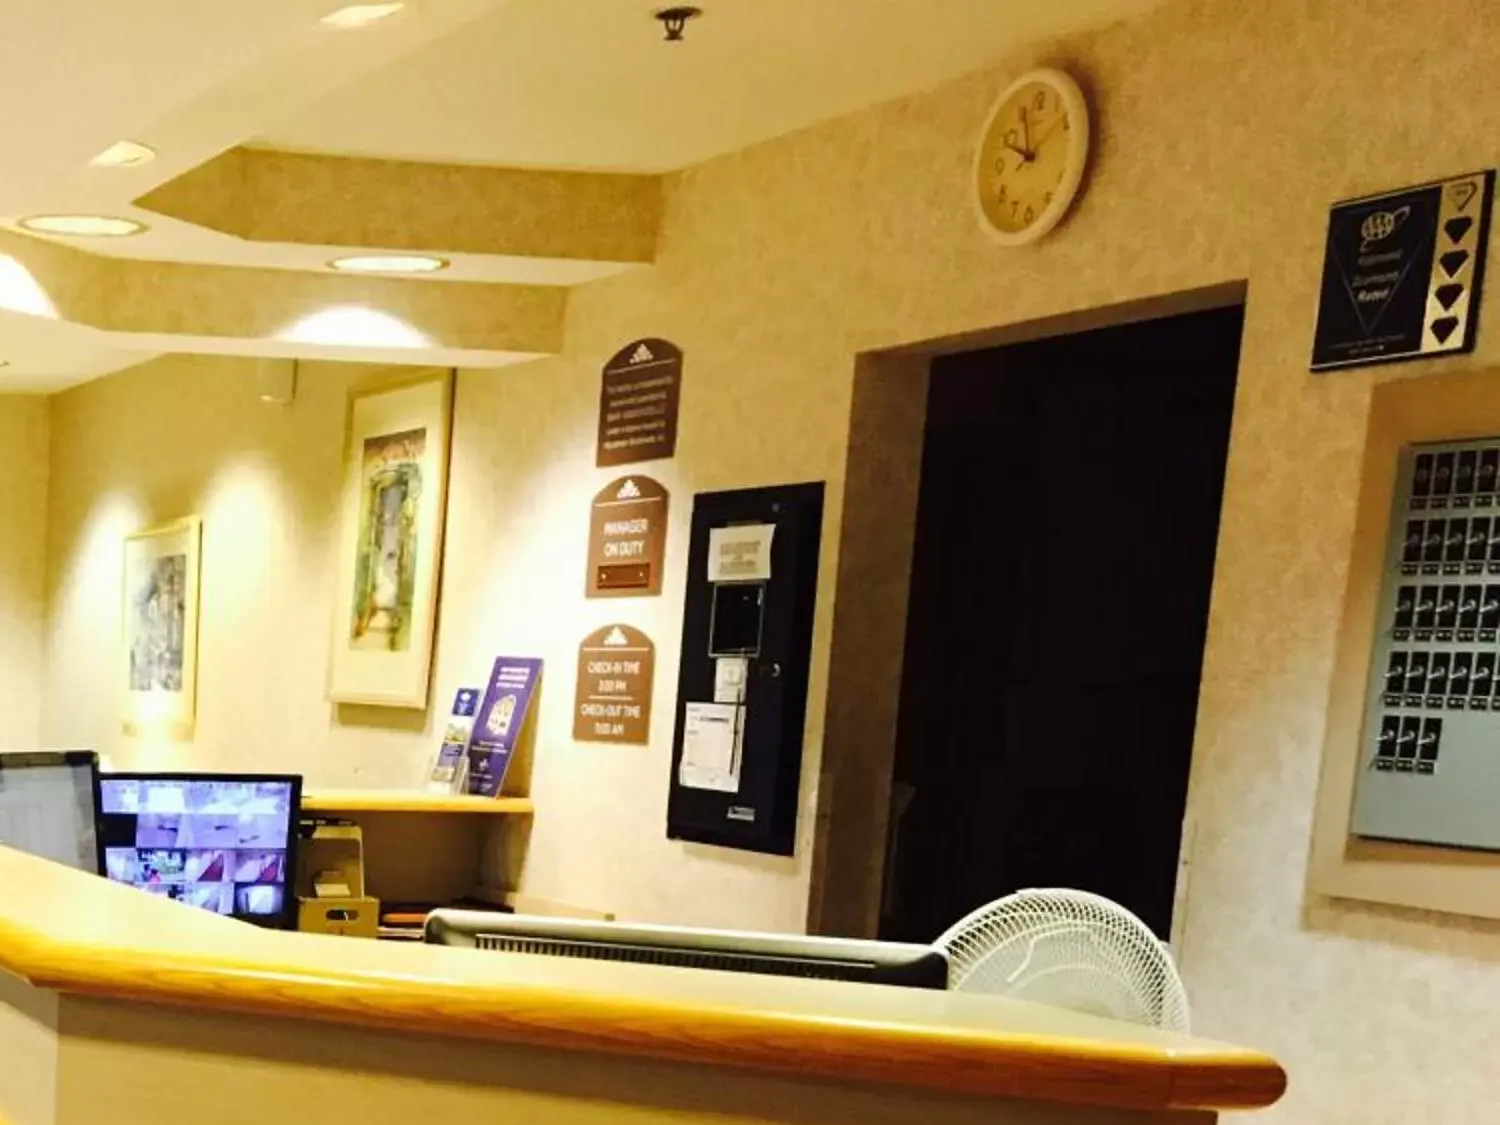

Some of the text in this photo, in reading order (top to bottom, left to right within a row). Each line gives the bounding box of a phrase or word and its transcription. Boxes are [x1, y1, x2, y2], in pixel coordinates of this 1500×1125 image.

[603, 518, 649, 536] MANAGER
[604, 540, 645, 558] ON DUTY
